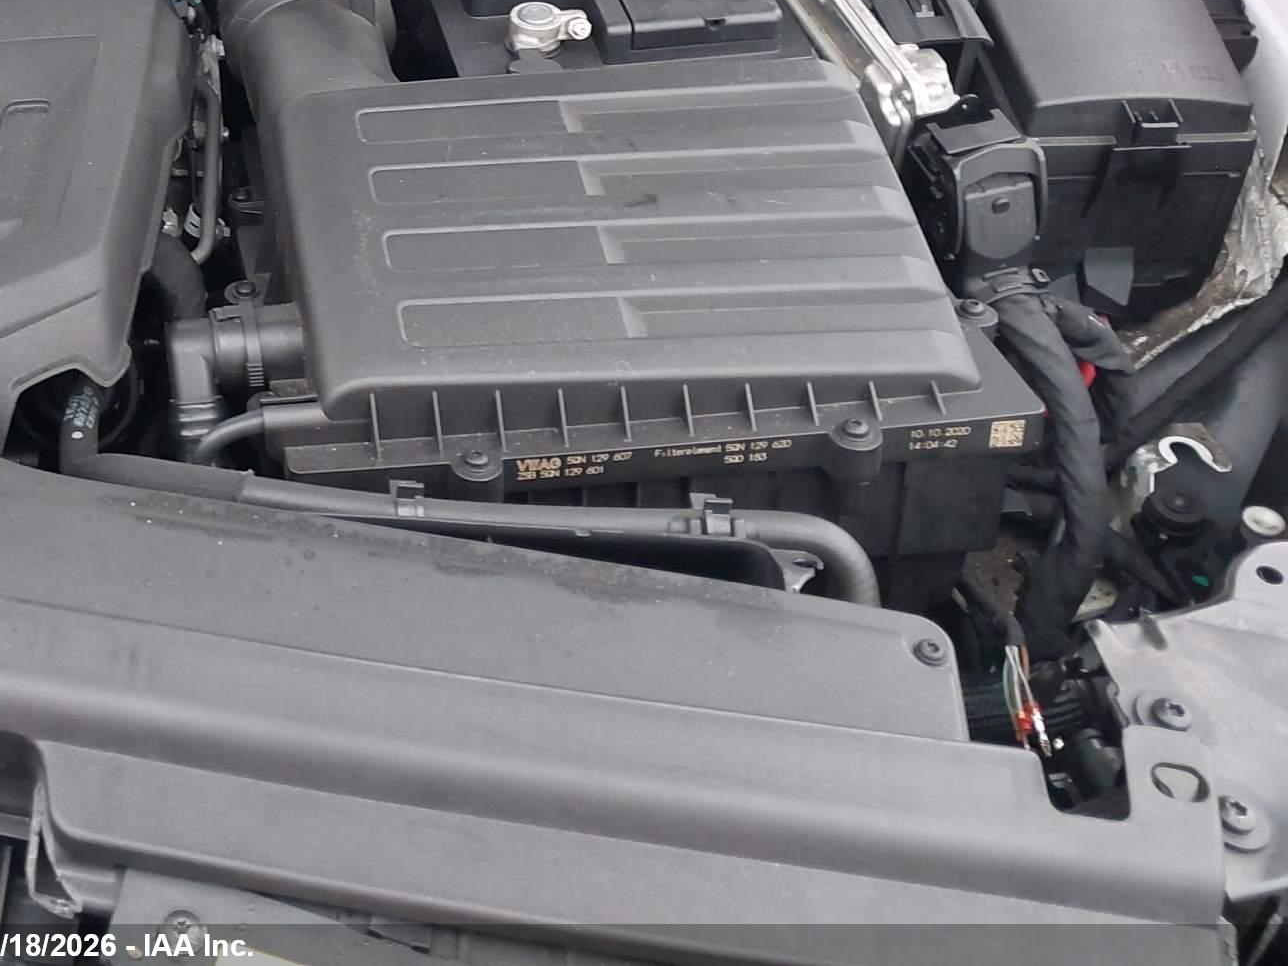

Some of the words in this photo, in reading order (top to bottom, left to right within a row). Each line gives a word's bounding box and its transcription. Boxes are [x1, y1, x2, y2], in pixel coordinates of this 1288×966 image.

[749, 440, 768, 450] 129
[909, 439, 958, 450] 14:04:42
[591, 452, 610, 463] 129
[564, 467, 583, 476] 129
[585, 466, 604, 476] 601
